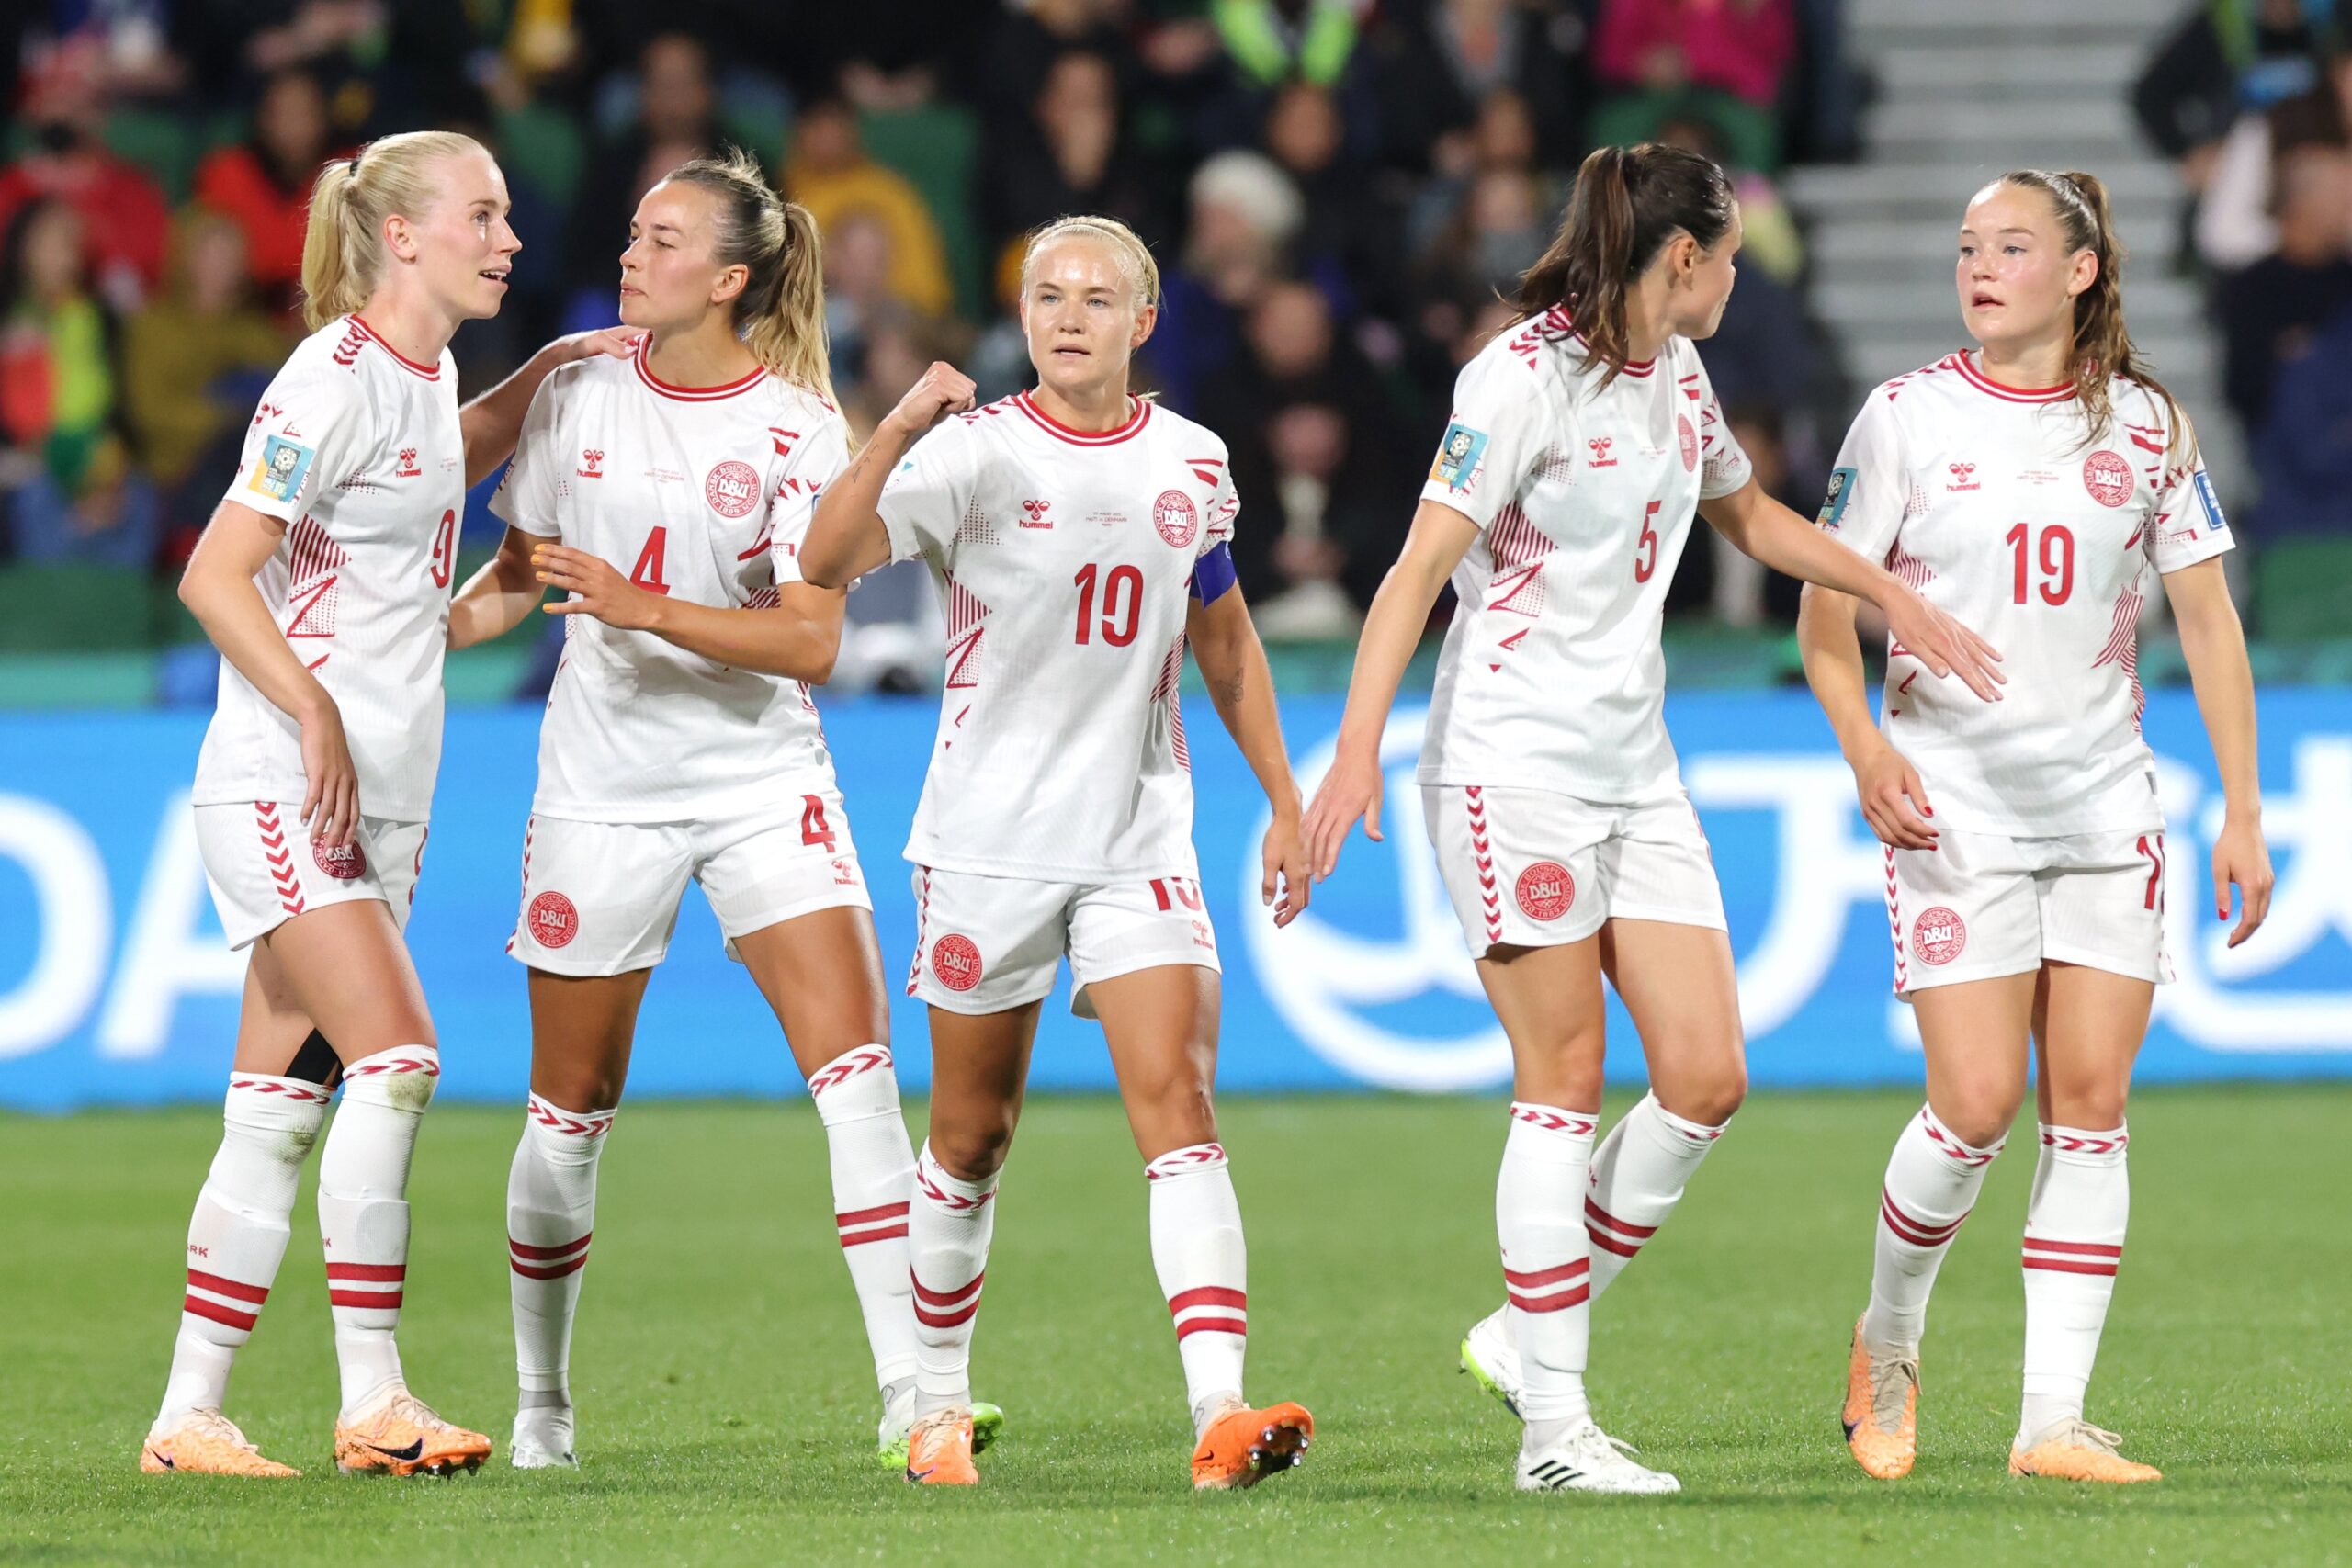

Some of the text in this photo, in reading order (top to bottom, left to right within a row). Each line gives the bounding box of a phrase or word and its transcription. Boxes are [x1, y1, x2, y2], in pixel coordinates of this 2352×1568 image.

[576, 468, 603, 479] hummel
[2094, 469, 2123, 487] DBU
[717, 478, 750, 500] DBU
[1946, 481, 1981, 491] hummel
[1019, 519, 1054, 529] hummel
[1163, 508, 1188, 527] DBU
[430, 508, 455, 589] 9
[1635, 500, 1662, 583] 5
[629, 525, 671, 596] 4
[2006, 523, 2075, 606] 19
[1074, 563, 1144, 648] 10
[799, 794, 836, 853] 4
[2136, 835, 2165, 915] 1
[1529, 881, 1562, 900] DBU
[538, 908, 567, 929] DBU
[1923, 925, 1953, 945] DBU
[943, 951, 971, 973] DBU
[187, 1244, 209, 1258] RK
